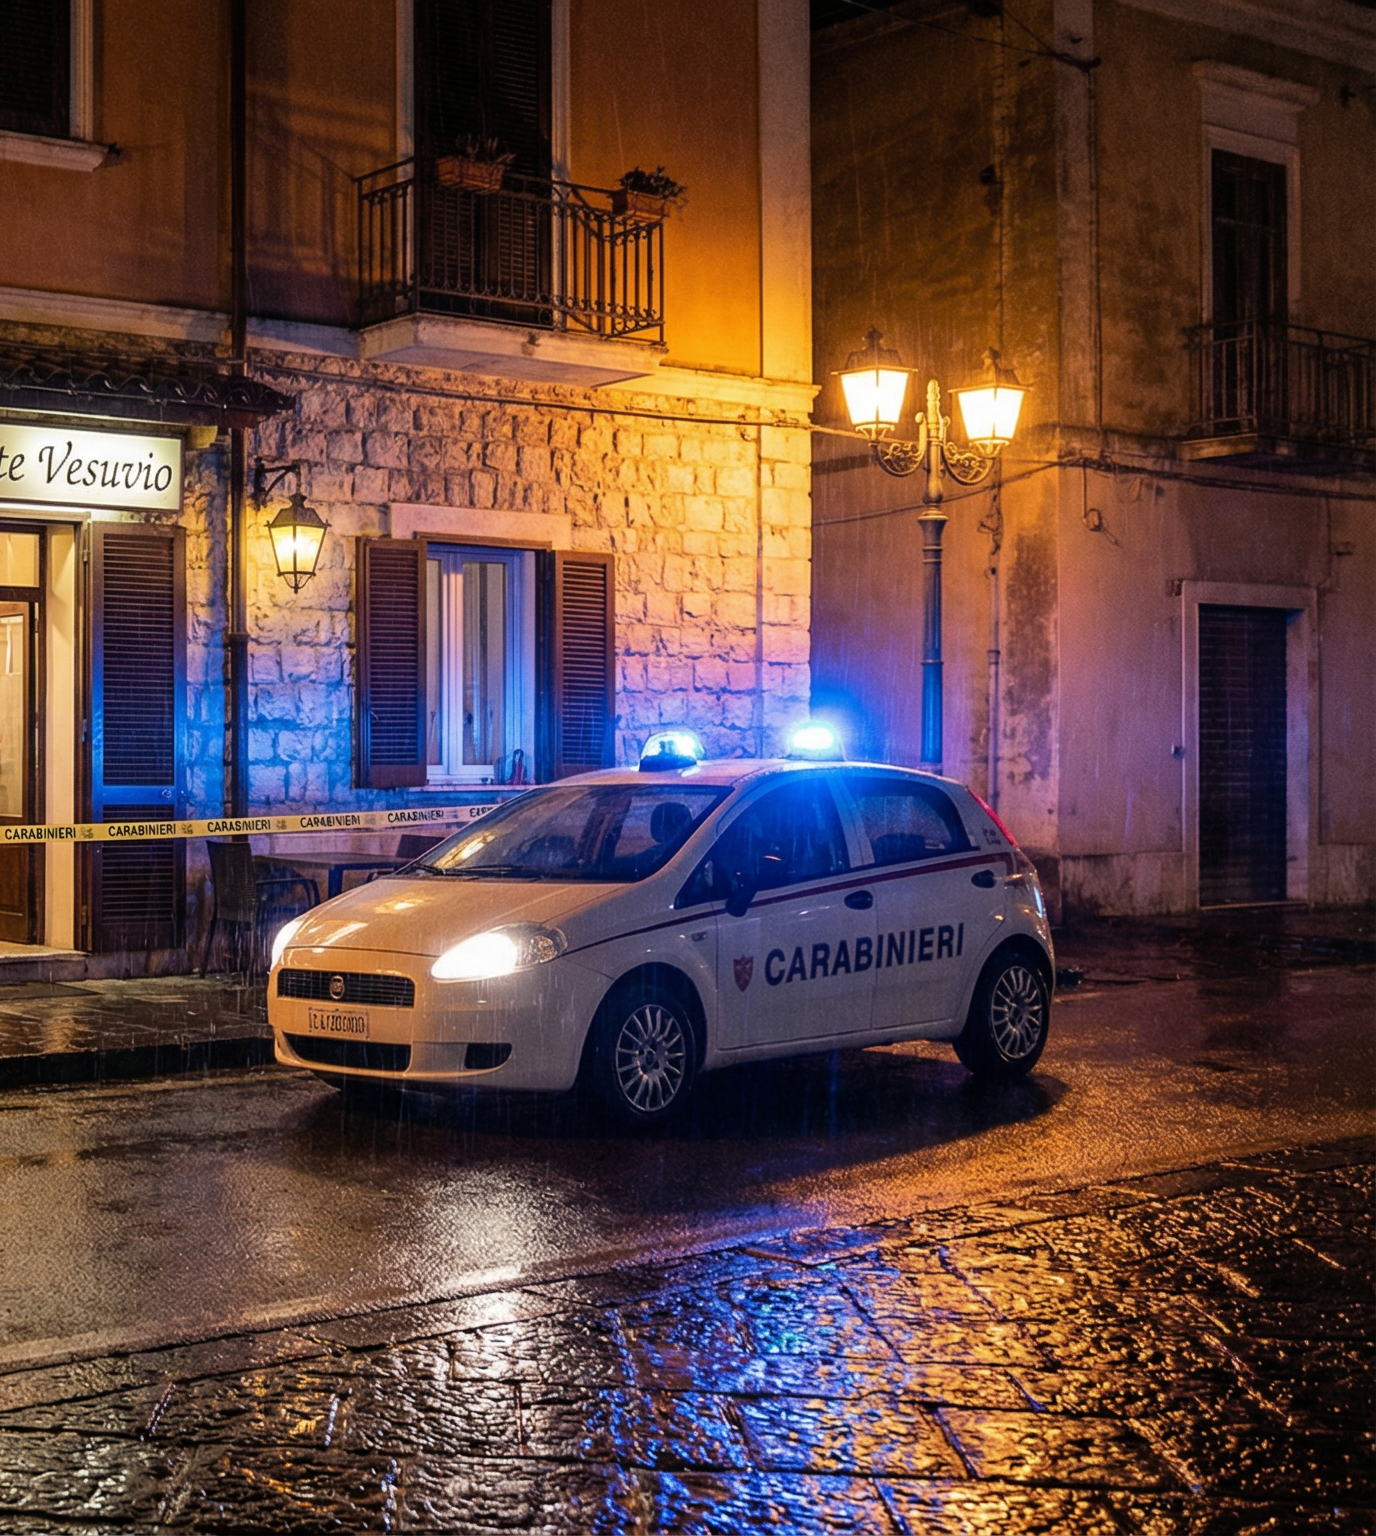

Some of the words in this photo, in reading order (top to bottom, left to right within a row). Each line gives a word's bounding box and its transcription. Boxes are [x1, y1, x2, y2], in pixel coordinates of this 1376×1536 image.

[38, 441, 173, 491] Vesuvio
[4, 827, 77, 840] CARABINIERI
[108, 823, 176, 837] CARABINIERI
[764, 922, 965, 987] CARABINIERI
